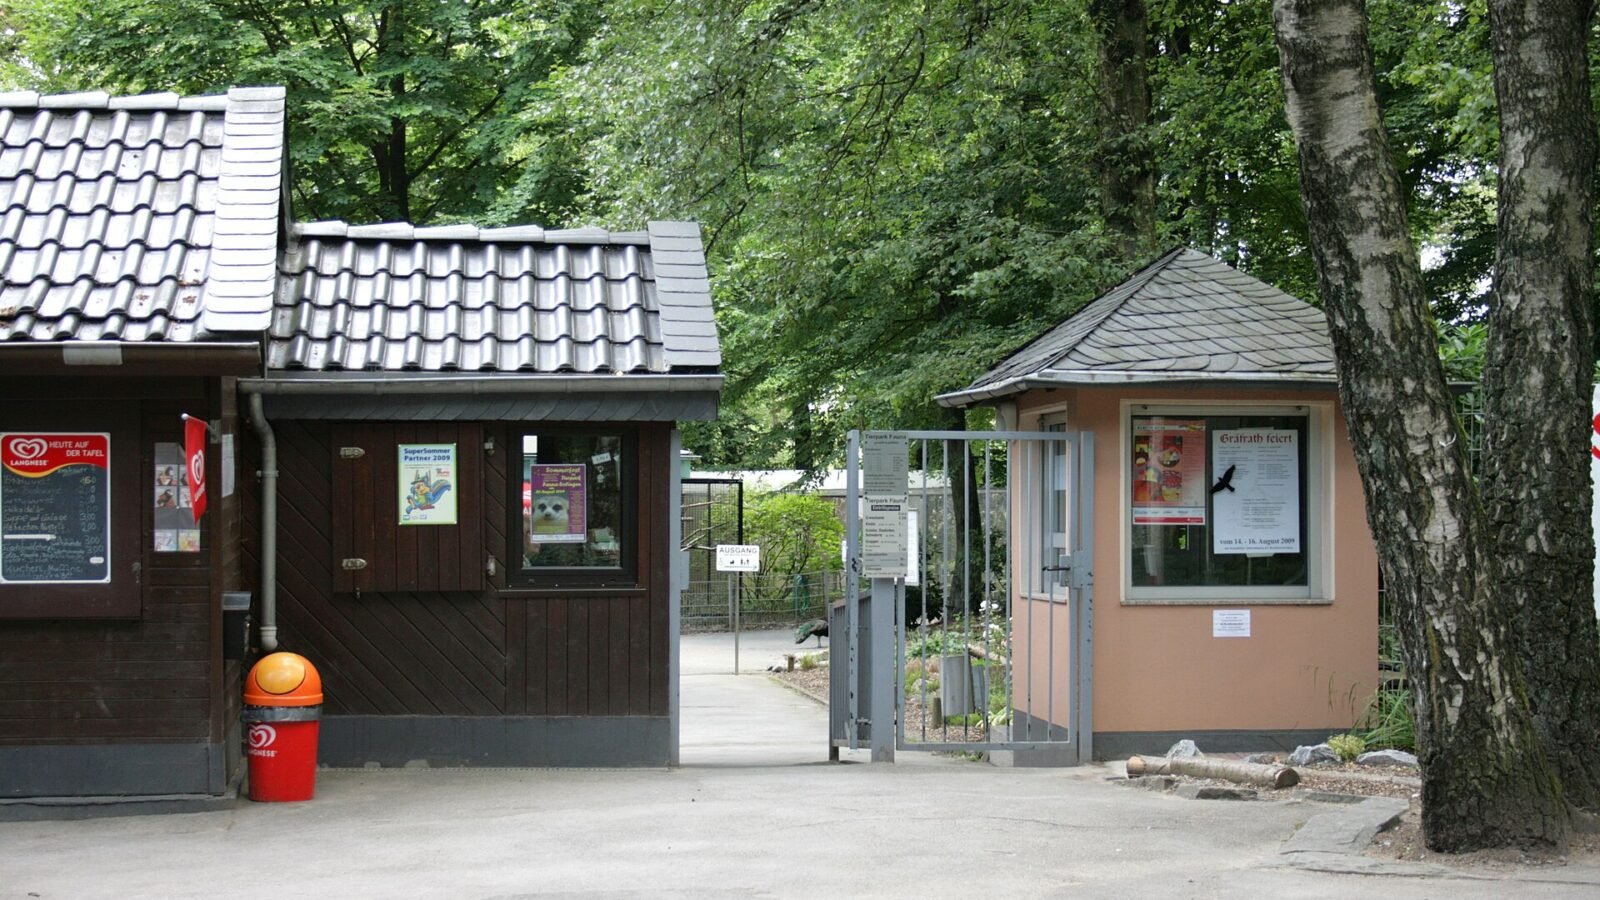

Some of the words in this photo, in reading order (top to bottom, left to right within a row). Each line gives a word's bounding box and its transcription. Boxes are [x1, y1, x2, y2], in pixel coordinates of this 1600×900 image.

[1266, 433, 1293, 443] feiert
[49, 441, 73, 449] HEUTE
[74, 441, 89, 449] AUF
[66, 449, 80, 457] DER
[83, 449, 104, 457] TAFEL
[1258, 538, 1280, 546] August
